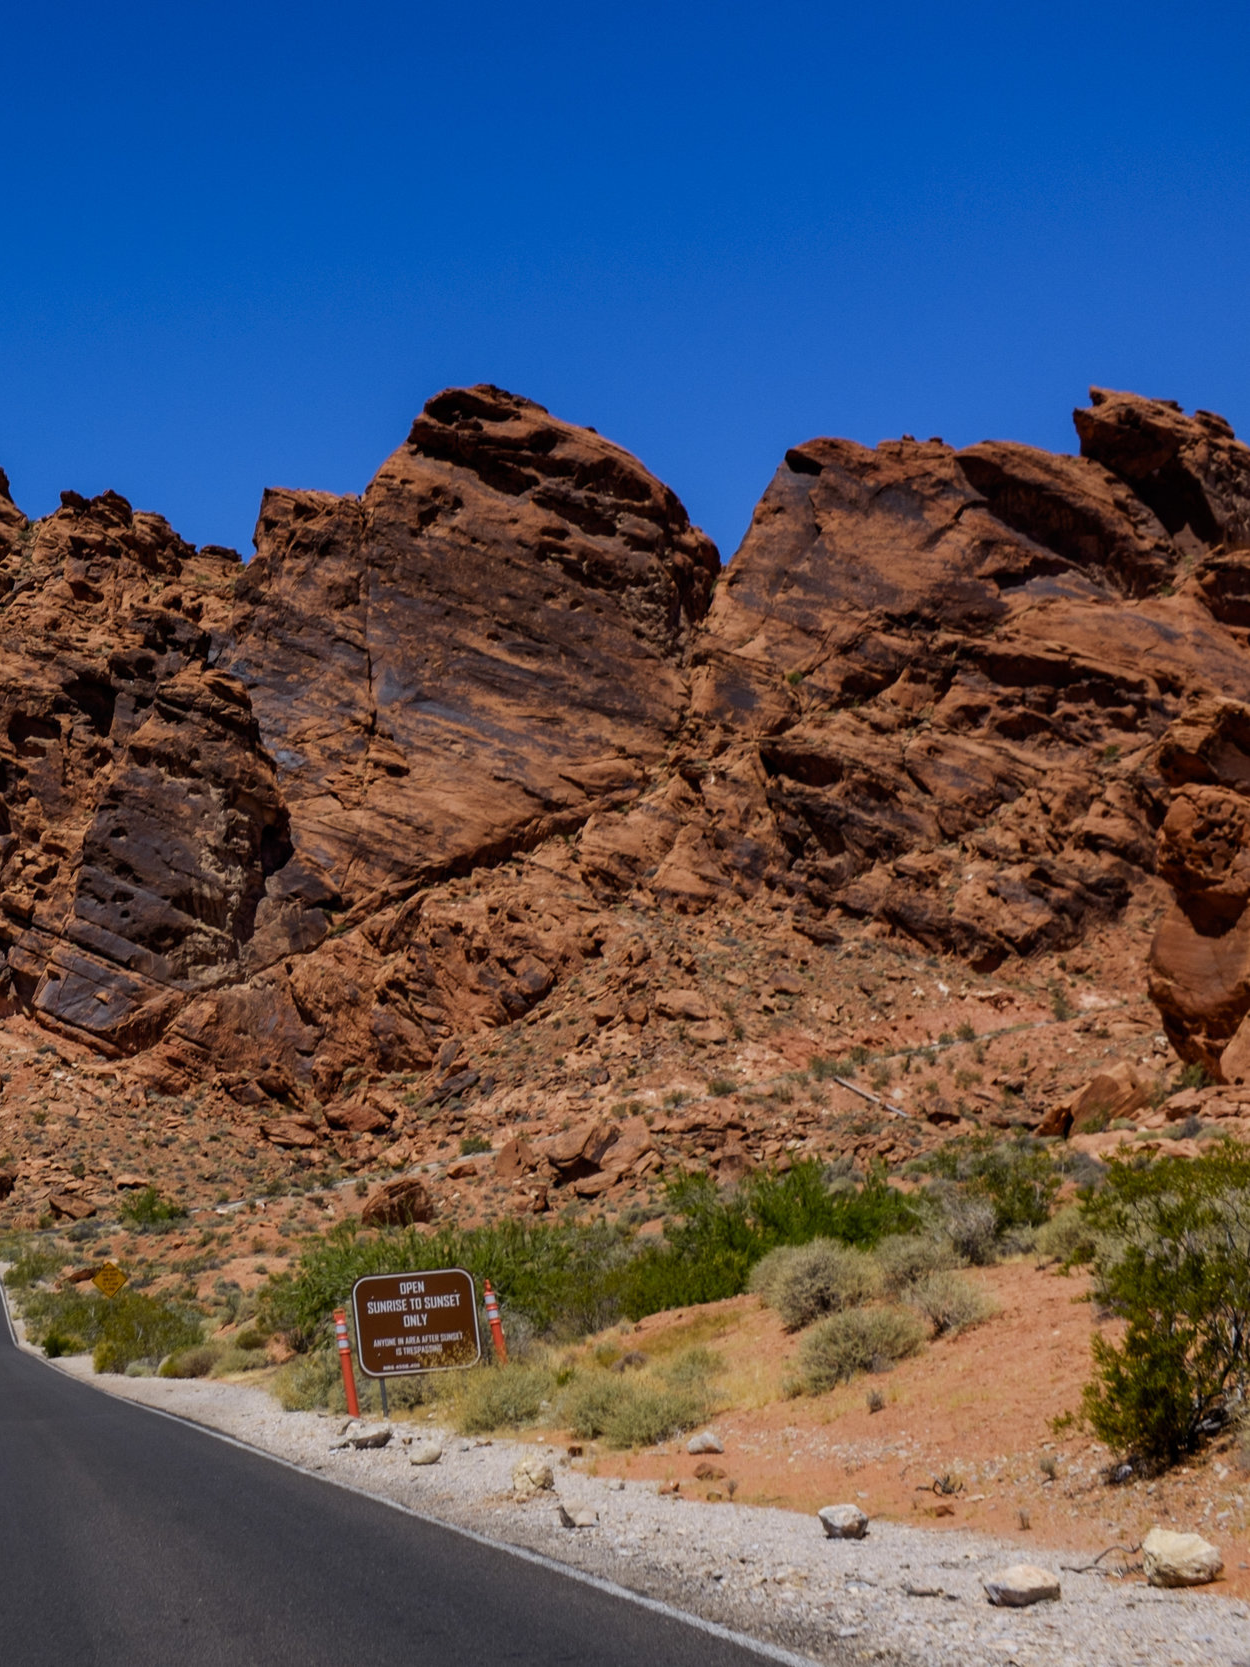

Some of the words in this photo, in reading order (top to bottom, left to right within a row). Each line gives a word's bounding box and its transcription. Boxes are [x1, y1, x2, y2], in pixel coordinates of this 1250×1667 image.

[399, 1281, 425, 1295] OPEN
[367, 1299, 407, 1314] SUNRISE
[410, 1298, 422, 1310] TO
[424, 1294, 461, 1309] SUNSET
[403, 1313, 428, 1327] ONLY
[373, 1338, 396, 1347] ANYONE
[398, 1337, 404, 1345] IN
[405, 1336, 420, 1345] AREA
[422, 1334, 439, 1343] AFTER
[396, 1347, 402, 1356] IS
